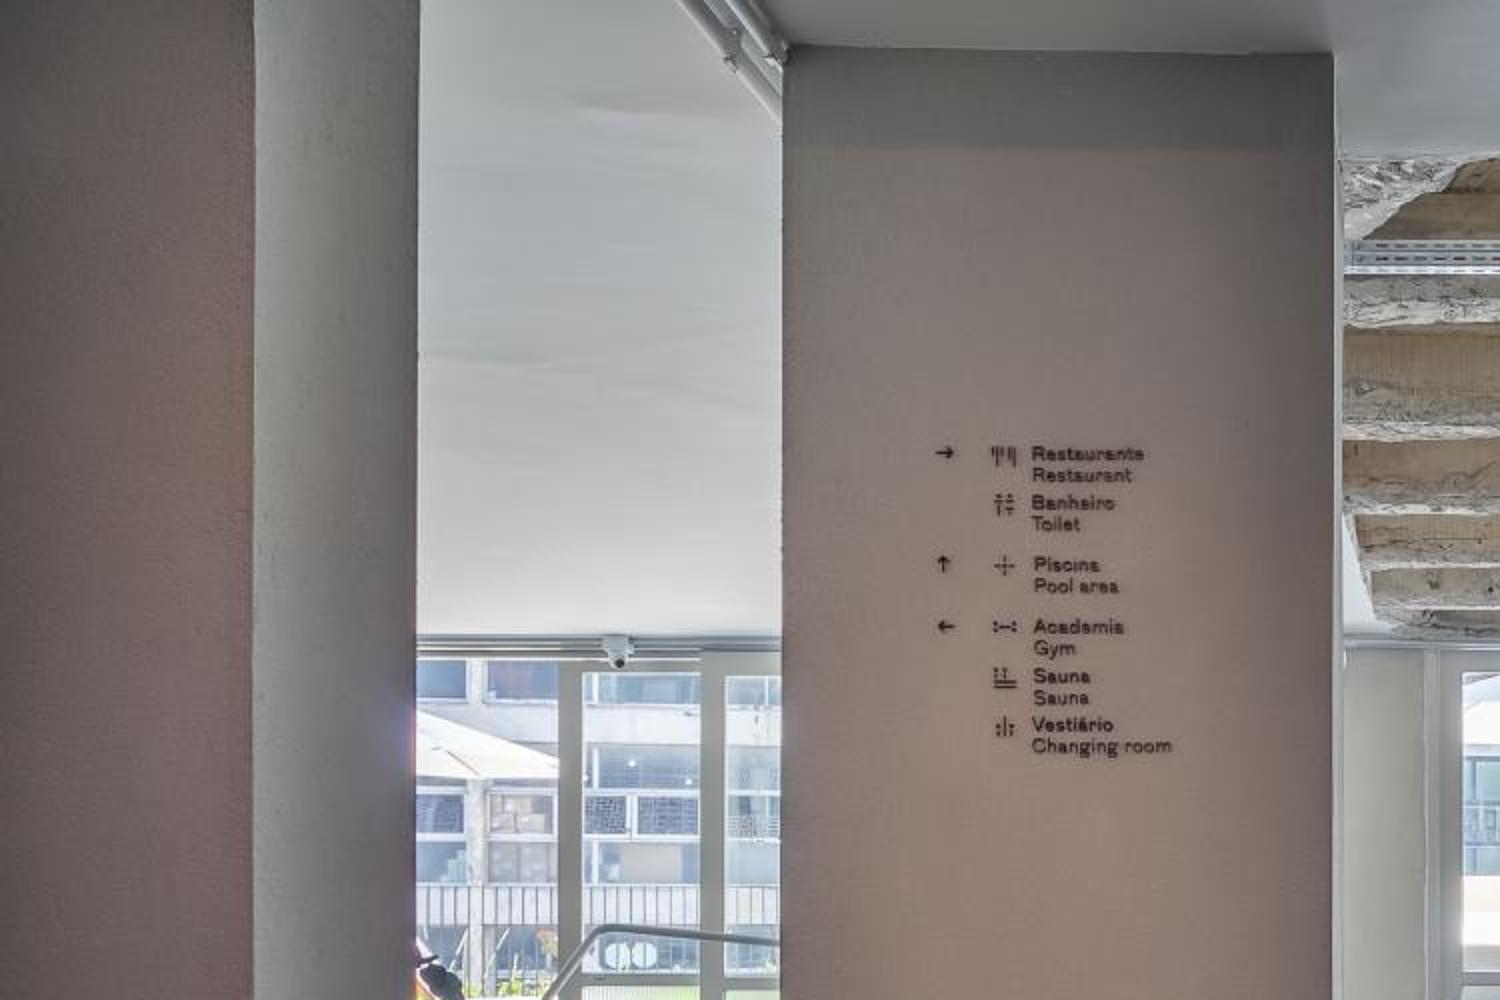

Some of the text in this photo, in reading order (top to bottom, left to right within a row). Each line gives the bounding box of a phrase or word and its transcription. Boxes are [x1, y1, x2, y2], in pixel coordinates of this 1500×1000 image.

[1031, 446, 1145, 461] Restaurante
[1032, 467, 1134, 482] Restaurant
[1031, 494, 1117, 511] Banheiro
[1030, 516, 1081, 532] Toilet
[1033, 556, 1101, 573] Piscina
[1034, 578, 1120, 594] Pool area
[1033, 618, 1125, 635] Academia
[1033, 640, 1076, 660] Gym
[1033, 668, 1092, 685] Sauna
[1033, 690, 1090, 706] Sauna
[1031, 716, 1115, 733] Vestiário
[1031, 738, 1172, 758] Changing room
